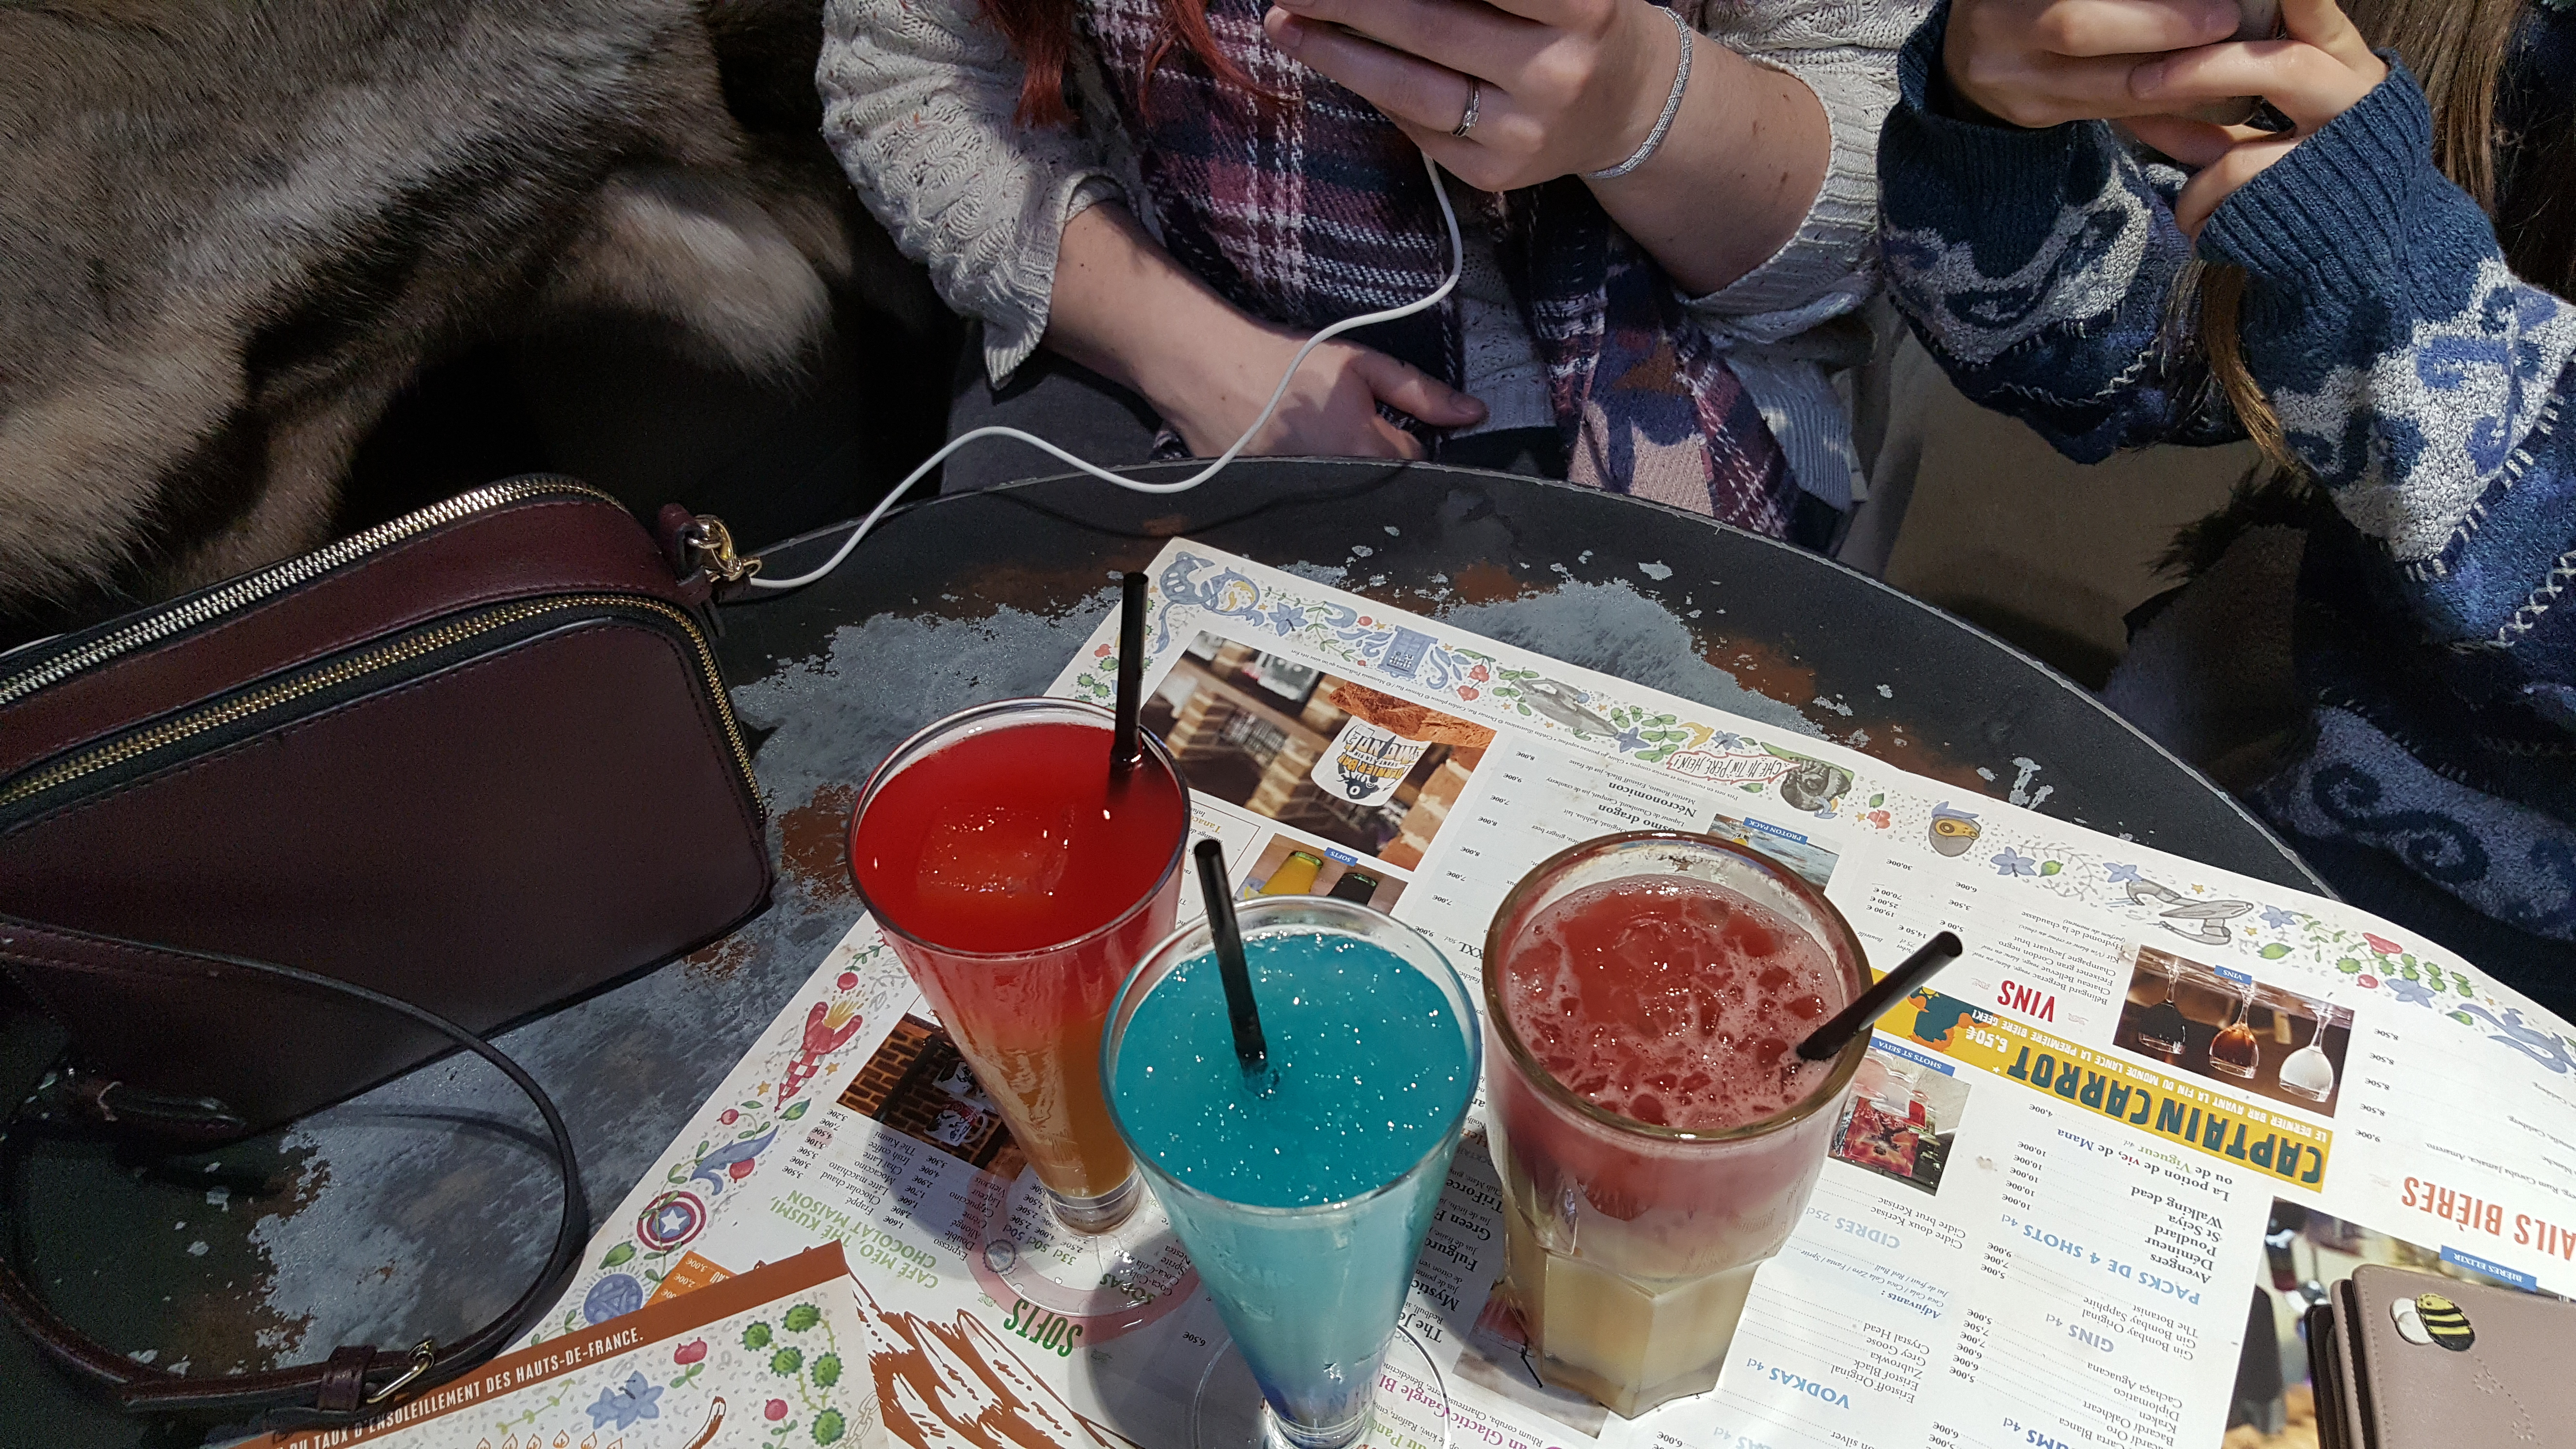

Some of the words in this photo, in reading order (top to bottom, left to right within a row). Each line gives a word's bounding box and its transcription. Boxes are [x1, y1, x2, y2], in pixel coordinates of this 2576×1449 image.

[1515, 749, 1535, 762] 8,00€
[1356, 751, 1405, 788] DERNIER
[1502, 770, 1523, 784] 9,00€
[1609, 782, 1696, 817] Nécronomicon
[1598, 804, 1640, 823] dragon
[1748, 820, 1769, 830] PACK
[1769, 823, 1801, 844] PROTON
[1329, 849, 1352, 863] SOFTS
[2021, 911, 2059, 928] chaudasse
[1412, 925, 1434, 936] 9,00€
[2013, 935, 2030, 947] brut
[2082, 932, 2123, 954] Hydromel
[2032, 942, 2066, 959] Jacquart
[2067, 955, 2115, 976] Champagne
[2222, 969, 2242, 980] VINS
[1996, 980, 2054, 1022] VINS
[1971, 1009, 2001, 1028] GEEK!
[1965, 1022, 2008, 1052] 6,50€
[2000, 1020, 2028, 1037] BIÈRE
[1877, 1040, 1901, 1054] SEIYA
[2029, 1031, 2077, 1056] PREMIÈRE
[1913, 1054, 1942, 1068] SHOTS
[2080, 1049, 2091, 1061] LA
[2093, 1055, 2123, 1073] LANCE
[2006, 1045, 2152, 1124] CARROT
[2125, 1065, 2158, 1086] MONDE
[2161, 1079, 2174, 1091] DU
[2176, 1084, 2194, 1098] FIN
[2197, 1091, 2209, 1103] LA
[2211, 1096, 2244, 1115] AVANT
[819, 1117, 839, 1130] 7,00€
[826, 1108, 848, 1121] 3,20€
[2247, 1108, 2267, 1123] BAR
[2270, 1114, 2312, 1137] DERNIER
[871, 1128, 900, 1148] Kusmi
[2057, 1128, 2094, 1150] Mana
[2155, 1097, 2331, 1183] CAPTAIN
[2314, 1130, 2326, 1143] LE
[868, 1142, 892, 1158] coffee
[892, 1151, 910, 1165] Irish
[900, 1143, 916, 1156] Thé
[2018, 1141, 2045, 1157] 10,00€
[2097, 1144, 2113, 1156] de
[2118, 1150, 2140, 1165] vie,
[789, 1156, 811, 1168] 3,00€
[2013, 1154, 2041, 1170] 10,00€
[2137, 1146, 2190, 1173] Vigueur
[2144, 1162, 2159, 1174] de
[820, 1171, 848, 1188] chaud
[850, 1160, 898, 1187] Mocaccino
[2008, 1165, 2039, 1183] 10,00€
[2164, 1169, 2208, 1190] potion
[2195, 1166, 2210, 1178] de
[2213, 1172, 2233, 1188] ou
[849, 1183, 884, 1205] Chocolat
[2005, 1179, 2035, 1196] 10,00€
[2130, 1186, 2162, 1204] dead
[2212, 1187, 2229, 1202] La
[783, 1189, 851, 1227] MAISON
[844, 1197, 875, 1215] Frappé
[1878, 1197, 1912, 1216] Kerisac
[2001, 1193, 2029, 1209] 10,00€
[2401, 1176, 2502, 1236] BIÈRES
[770, 1195, 821, 1231] KUSMI,
[883, 1215, 903, 1228] 1,60€
[1870, 1206, 1905, 1225] Kerisac
[1915, 1211, 1936, 1226] brut
[2165, 1196, 2222, 1229] Walking
[1450, 1213, 1490, 1240] Green
[1834, 1217, 1900, 1248] CIDRES
[1908, 1220, 1932, 1235] doux
[1938, 1221, 1965, 1238] Cidre
[2168, 1214, 2203, 1235] Seiya
[846, 1220, 936, 1268] CHOCOLAT
[1935, 1231, 1962, 1249] Cidre
[2023, 1224, 2083, 1257] SHOTS
[2154, 1224, 2216, 1256] Poudlard
[2206, 1229, 2221, 1242] St
[859, 1239, 898, 1269] MÉO,
[933, 1238, 971, 1260] Expresso
[1987, 1241, 2011, 1257] 9,00€
[2090, 1252, 2100, 1264] 4
[2144, 1236, 2212, 1271] Démineur
[685, 1257, 708, 1272] 3,00€
[1160, 1256, 1188, 1276] Sprite
[1983, 1252, 2008, 1268] 7,00€
[2107, 1258, 2131, 1278] DE
[2150, 1254, 2211, 1283] Avengers
[673, 1272, 695, 1287] 2,00€
[896, 1261, 938, 1288] CAFÉ
[1980, 1263, 2005, 1278] 5,00€
[2138, 1272, 2200, 1305] PACKS
[1887, 1292, 1941, 1318] Adjuvants
[2083, 1296, 2127, 1321] Sapphire
[1003, 1294, 1087, 1356] SOFTS
[1966, 1308, 1992, 1324] 5,00€
[2082, 1308, 2124, 1332] Original
[2133, 1304, 2173, 1328] Botanist
[1415, 1320, 1443, 1343] The
[1863, 1322, 1891, 1339] Head
[1963, 1320, 1989, 1336] 7,50€
[2129, 1315, 2172, 1340] Bombay
[2177, 1322, 2197, 1338] The
[1866, 1337, 1898, 1354] Goose
[1893, 1333, 1929, 1354] Crystal
[1960, 1331, 1985, 1348] 7,00€
[2068, 1324, 2113, 1352] GINS
[2126, 1326, 2169, 1352] Bombay
[2176, 1334, 2195, 1348] Gin
[1900, 1348, 1926, 1366] Grey
[1956, 1342, 1981, 1358] 6,00€
[2173, 1346, 2193, 1360] Gin
[1853, 1359, 1881, 1377] Black
[1870, 1352, 1922, 1379] Zubrowka
[1952, 1354, 1978, 1370] 6,00€
[1830, 1365, 1873, 1386] Original
[1881, 1370, 1918, 1391] Eristof
[1949, 1366, 1975, 1382] 5,00€
[2087, 1362, 2136, 1389] Aguacana
[313, 1426, 348, 1449] TAUX
[486, 1371, 511, 1393] DES
[515, 1327, 647, 1383] HAUTS-DE-FRANCE.
[1769, 1367, 1849, 1409] VODKAS
[1873, 1382, 1915, 1403] Eristoff
[2139, 1384, 2182, 1408] Cachaça
[1401, 1383, 1450, 1417] Gargle
[2113, 1387, 2179, 1421] Diplomatico
[1390, 1410, 1417, 1431] Raifort,
[2083, 1400, 2130, 1428] Oakheart
[2139, 1411, 2176, 1433] Kraken
[1447, 1412, 1502, 1445] Glactic
[1489, 1415, 1516, 1432] coruba,
[2059, 1417, 2092, 1440] Blanca
[2106, 1425, 2127, 1440] Oro
[1420, 1426, 1437, 1442] kiwi,
[1518, 1430, 1543, 1447] Rhum
